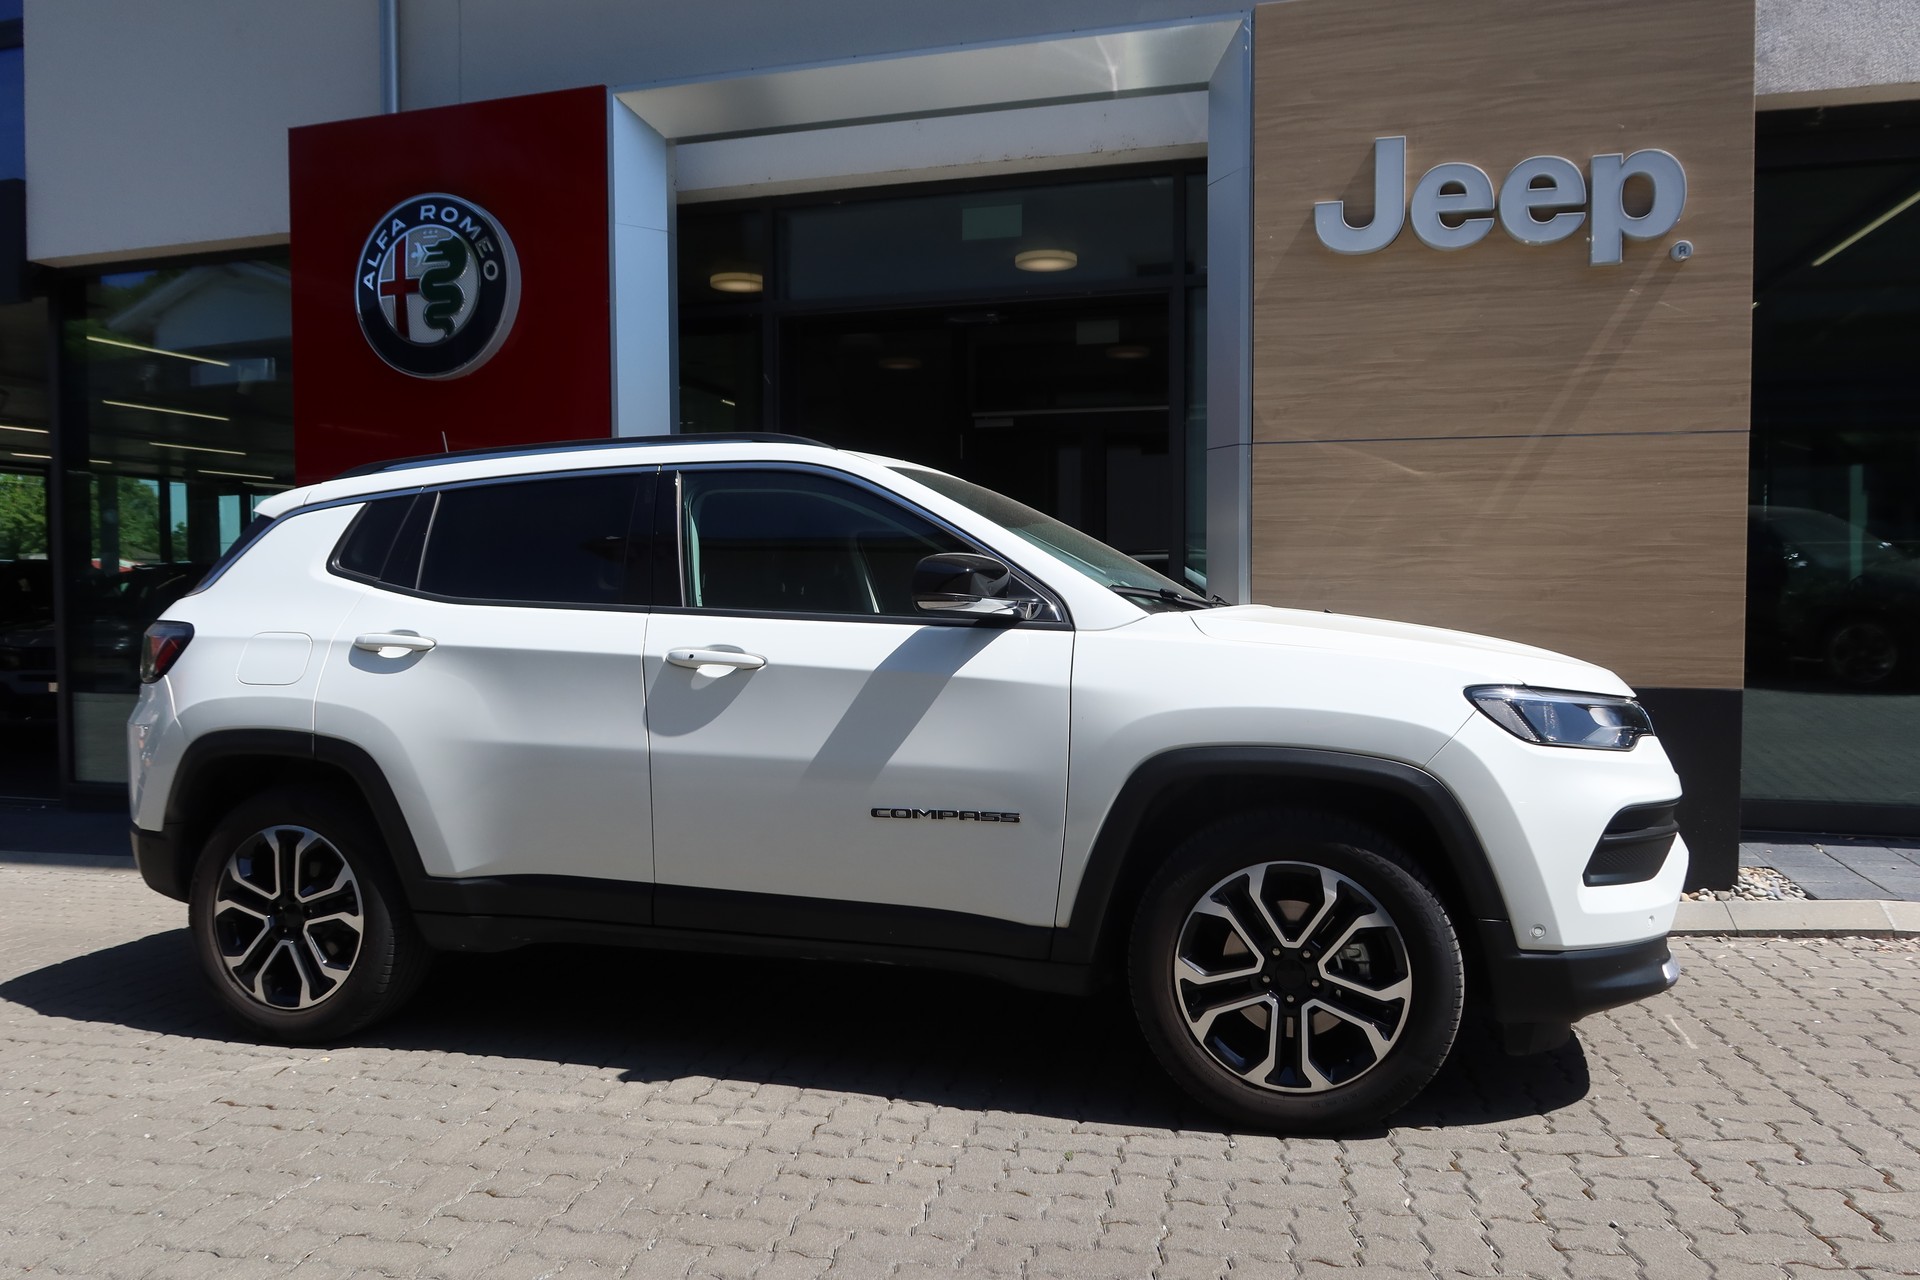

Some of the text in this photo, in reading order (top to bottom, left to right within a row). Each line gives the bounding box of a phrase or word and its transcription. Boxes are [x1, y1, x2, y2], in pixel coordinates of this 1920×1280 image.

[1314, 135, 1688, 267] Jeep
[362, 204, 499, 291] ALFA ROMEO
[870, 807, 1021, 823] COMPASS
